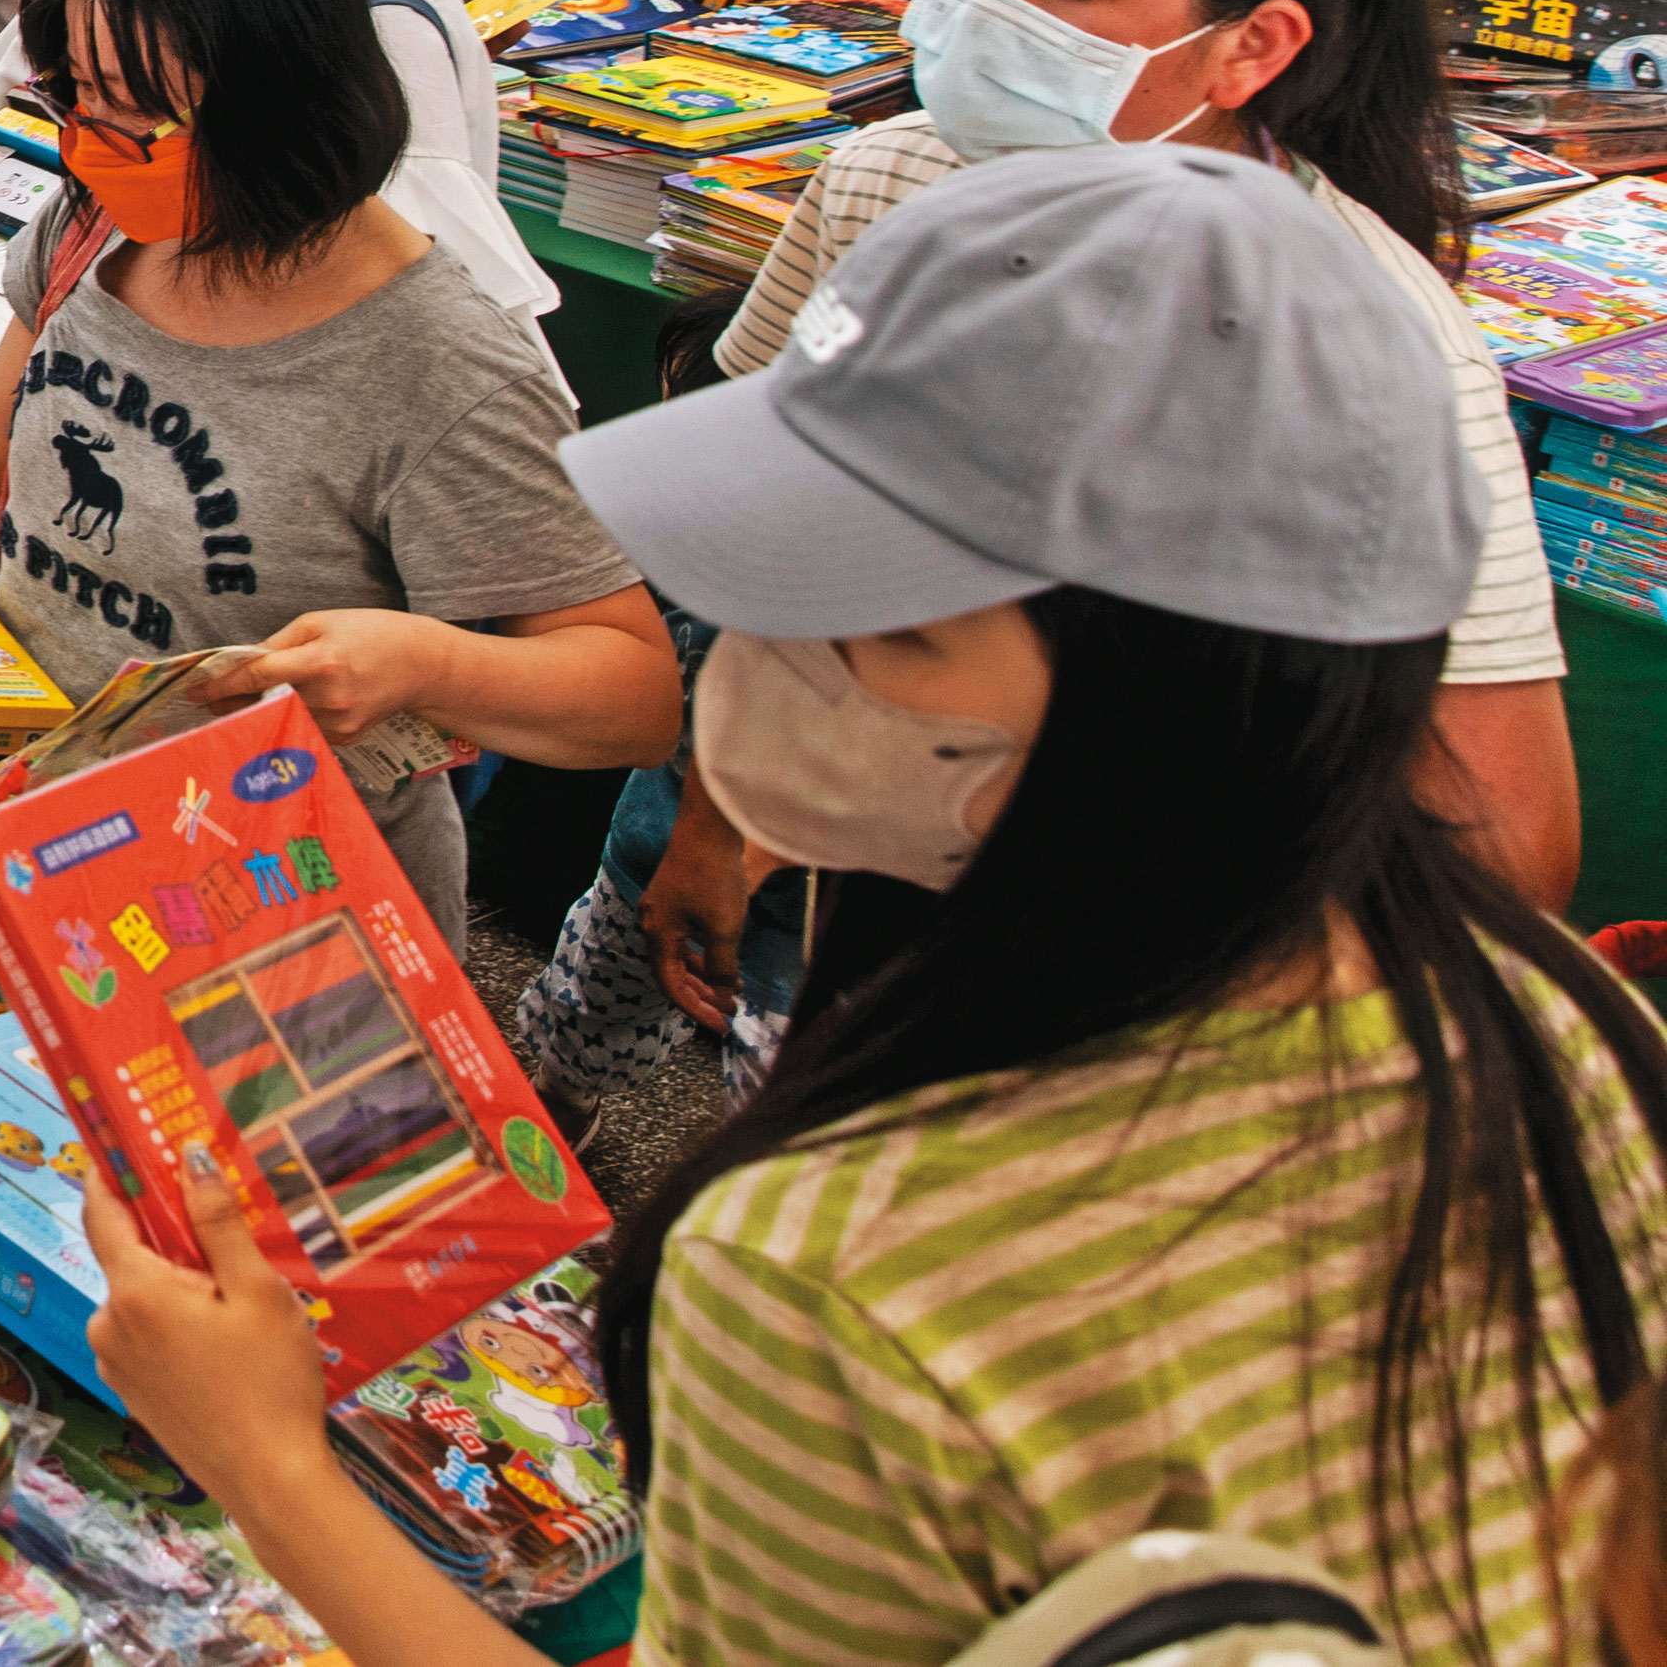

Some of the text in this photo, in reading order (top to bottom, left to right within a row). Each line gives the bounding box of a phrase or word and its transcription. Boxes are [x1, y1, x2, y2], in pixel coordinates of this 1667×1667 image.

[25, 534, 174, 650] FITCH
[108, 835, 342, 975] 智慧積木棒
